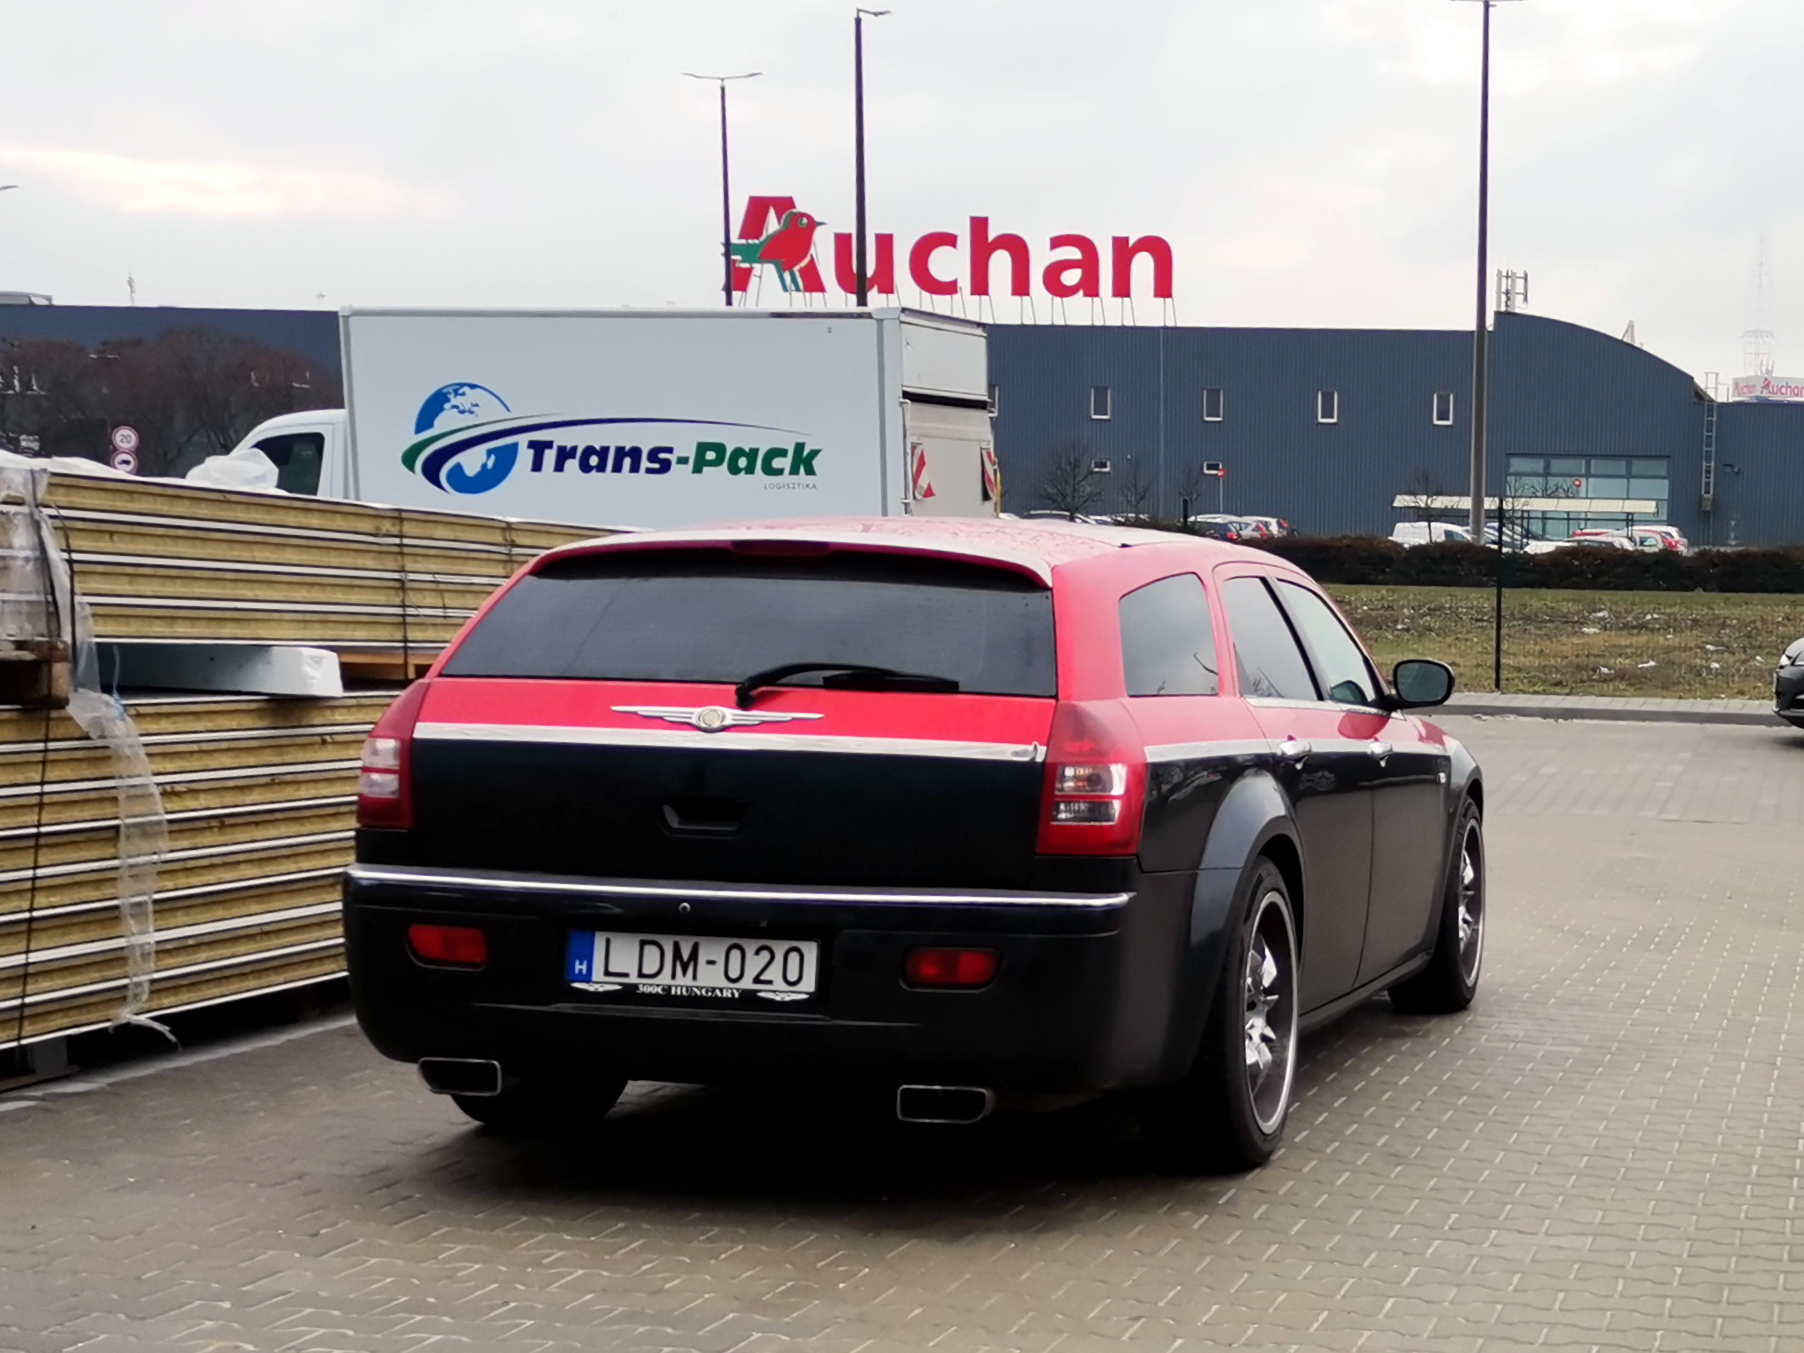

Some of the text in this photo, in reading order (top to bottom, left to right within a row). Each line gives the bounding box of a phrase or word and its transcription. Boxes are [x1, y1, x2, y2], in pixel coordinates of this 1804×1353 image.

[722, 195, 1174, 299] Auchan
[119, 433, 132, 444] 20
[526, 439, 823, 477] Trans-Pack
[763, 482, 817, 490] LOGISZTIKA
[574, 959, 588, 975] H
[603, 936, 805, 987] LDM-020
[636, 983, 742, 999] 300C HUNGARY
